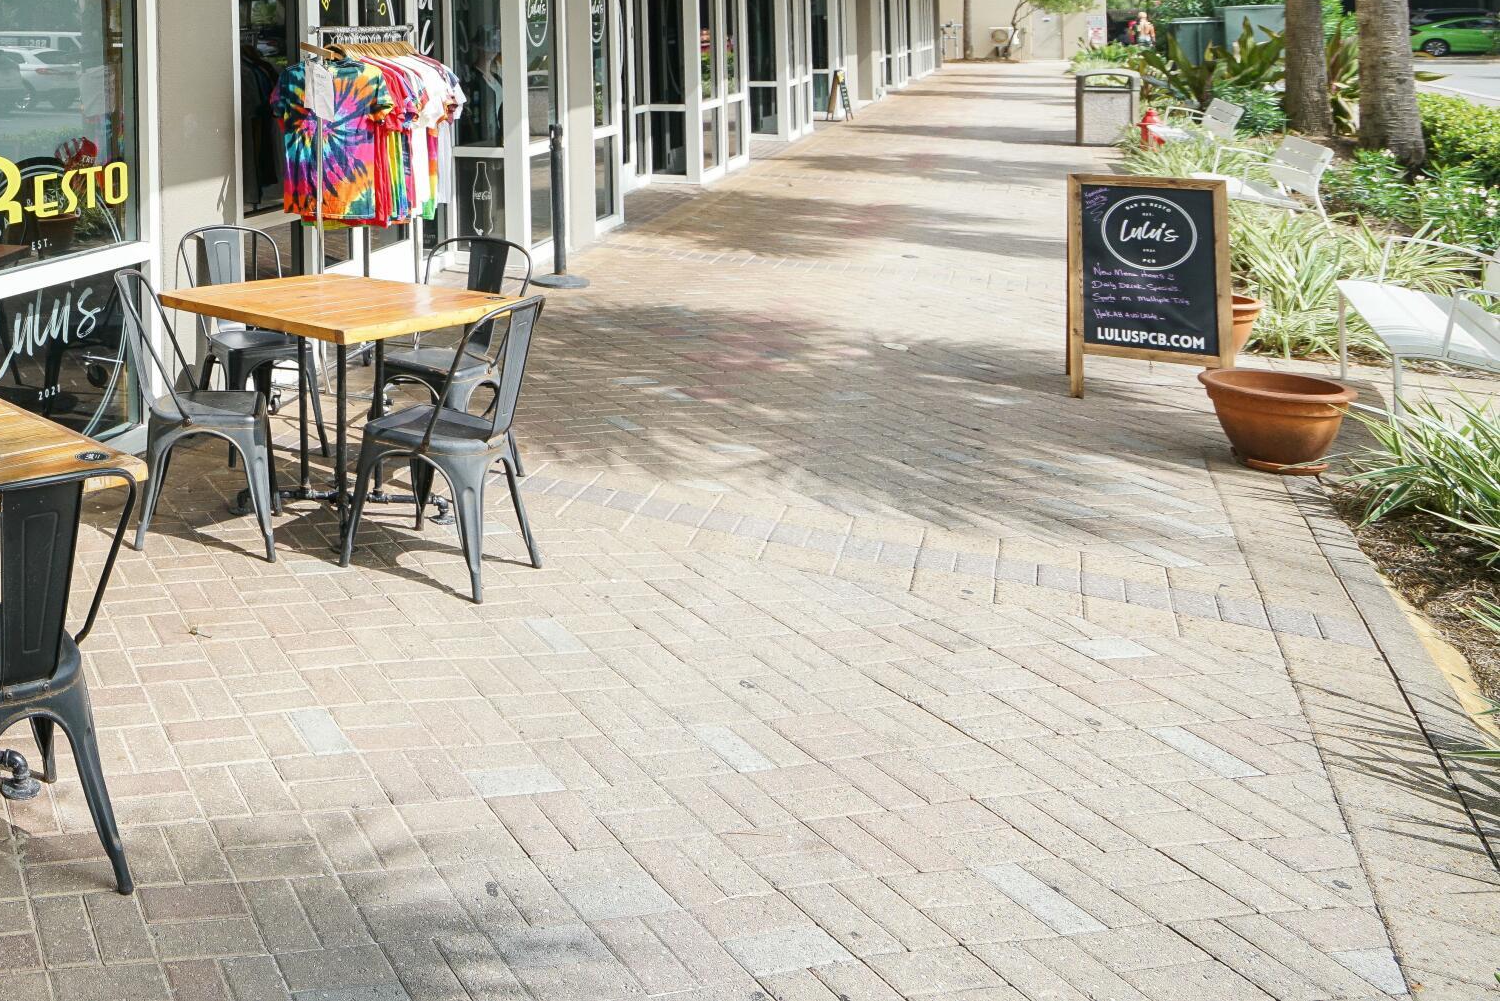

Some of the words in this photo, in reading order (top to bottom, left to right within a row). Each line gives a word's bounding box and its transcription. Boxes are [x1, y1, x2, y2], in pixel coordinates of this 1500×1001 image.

[1120, 219, 1179, 242] Lulu's
[31, 238, 53, 251] EST.
[1096, 326, 1205, 350] LULUSPCB.COM
[38, 385, 62, 400] 2021
